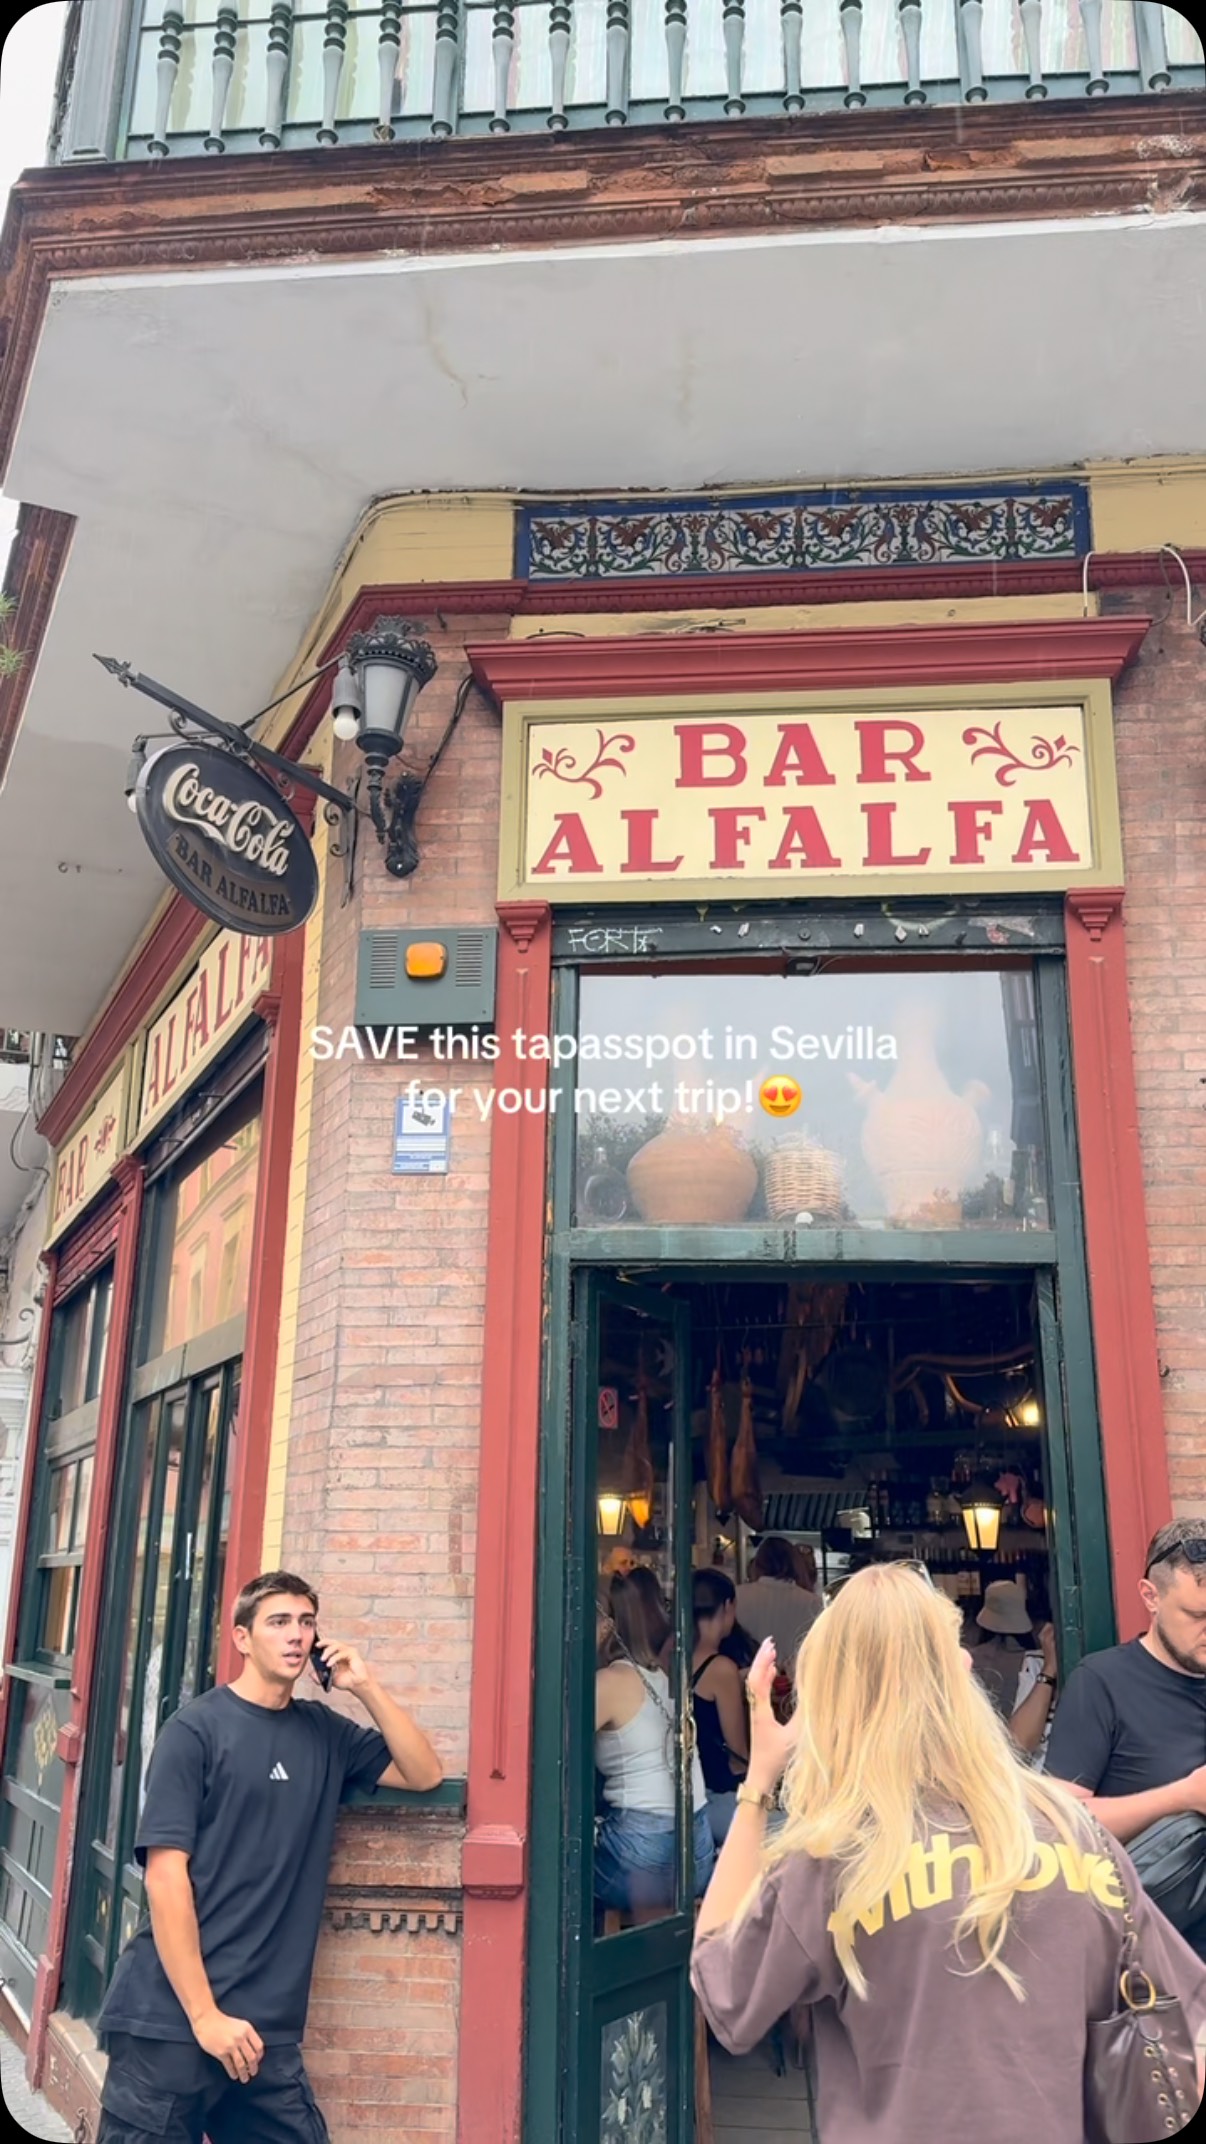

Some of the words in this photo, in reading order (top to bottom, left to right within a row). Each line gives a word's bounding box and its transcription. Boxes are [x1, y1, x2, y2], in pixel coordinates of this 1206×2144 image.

[674, 720, 931, 788] BAR
[175, 833, 213, 888] BAR
[216, 876, 291, 916] ALFALFA
[531, 799, 1080, 876] ALFALFA
[54, 1134, 90, 1222] BAR
